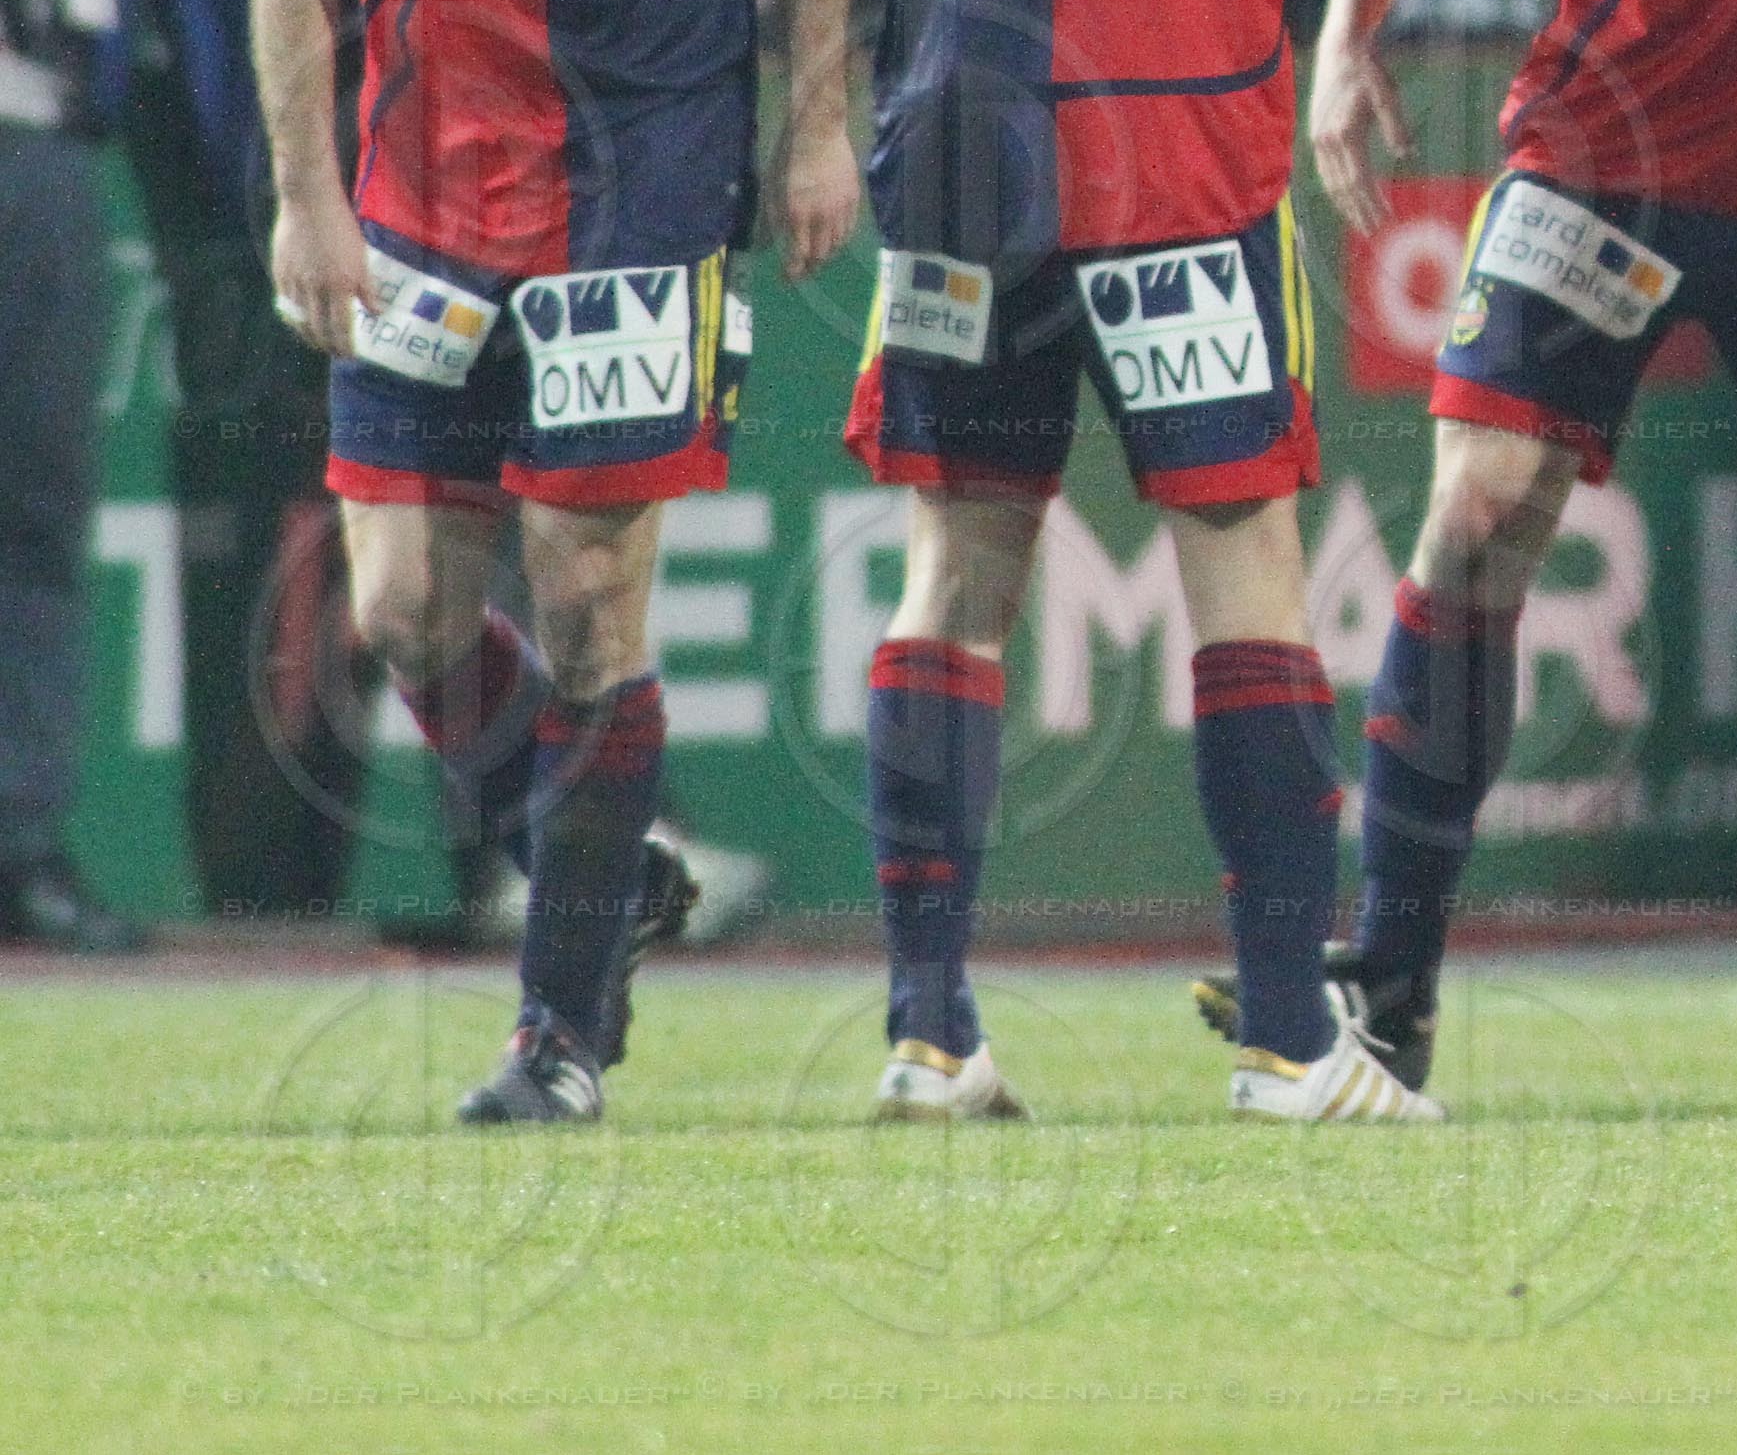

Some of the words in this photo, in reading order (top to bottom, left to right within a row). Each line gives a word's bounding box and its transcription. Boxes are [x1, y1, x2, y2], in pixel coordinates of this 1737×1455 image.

[1507, 202, 1588, 247] card
[540, 352, 682, 418] OMV
[1113, 329, 1255, 403] OMV
